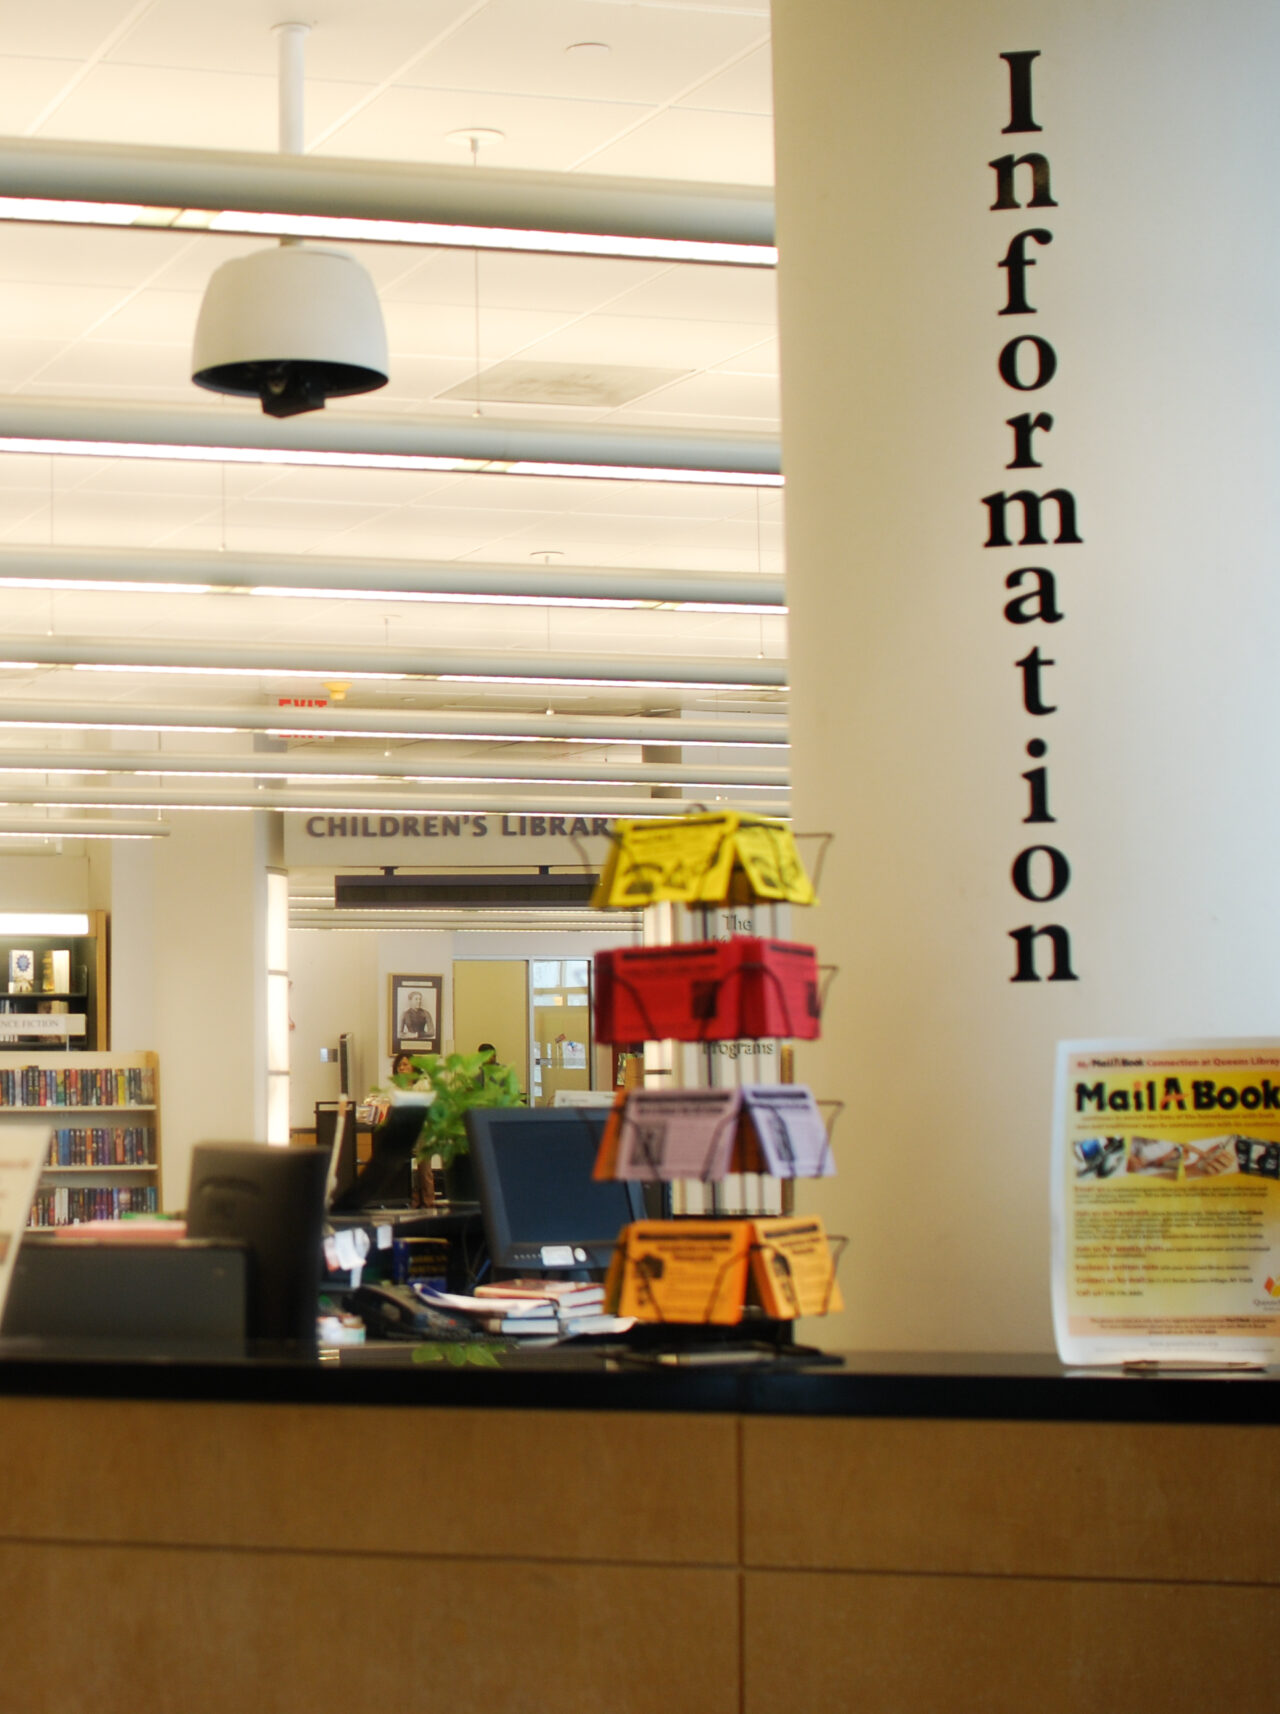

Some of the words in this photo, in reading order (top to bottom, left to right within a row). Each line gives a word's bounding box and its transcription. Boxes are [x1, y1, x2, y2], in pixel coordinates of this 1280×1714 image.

[980, 49, 1084, 983] Information
[305, 814, 488, 838] CHILDREN'S
[501, 815, 616, 837] LIBRAR
[22, 1020, 59, 1029] FICTION
